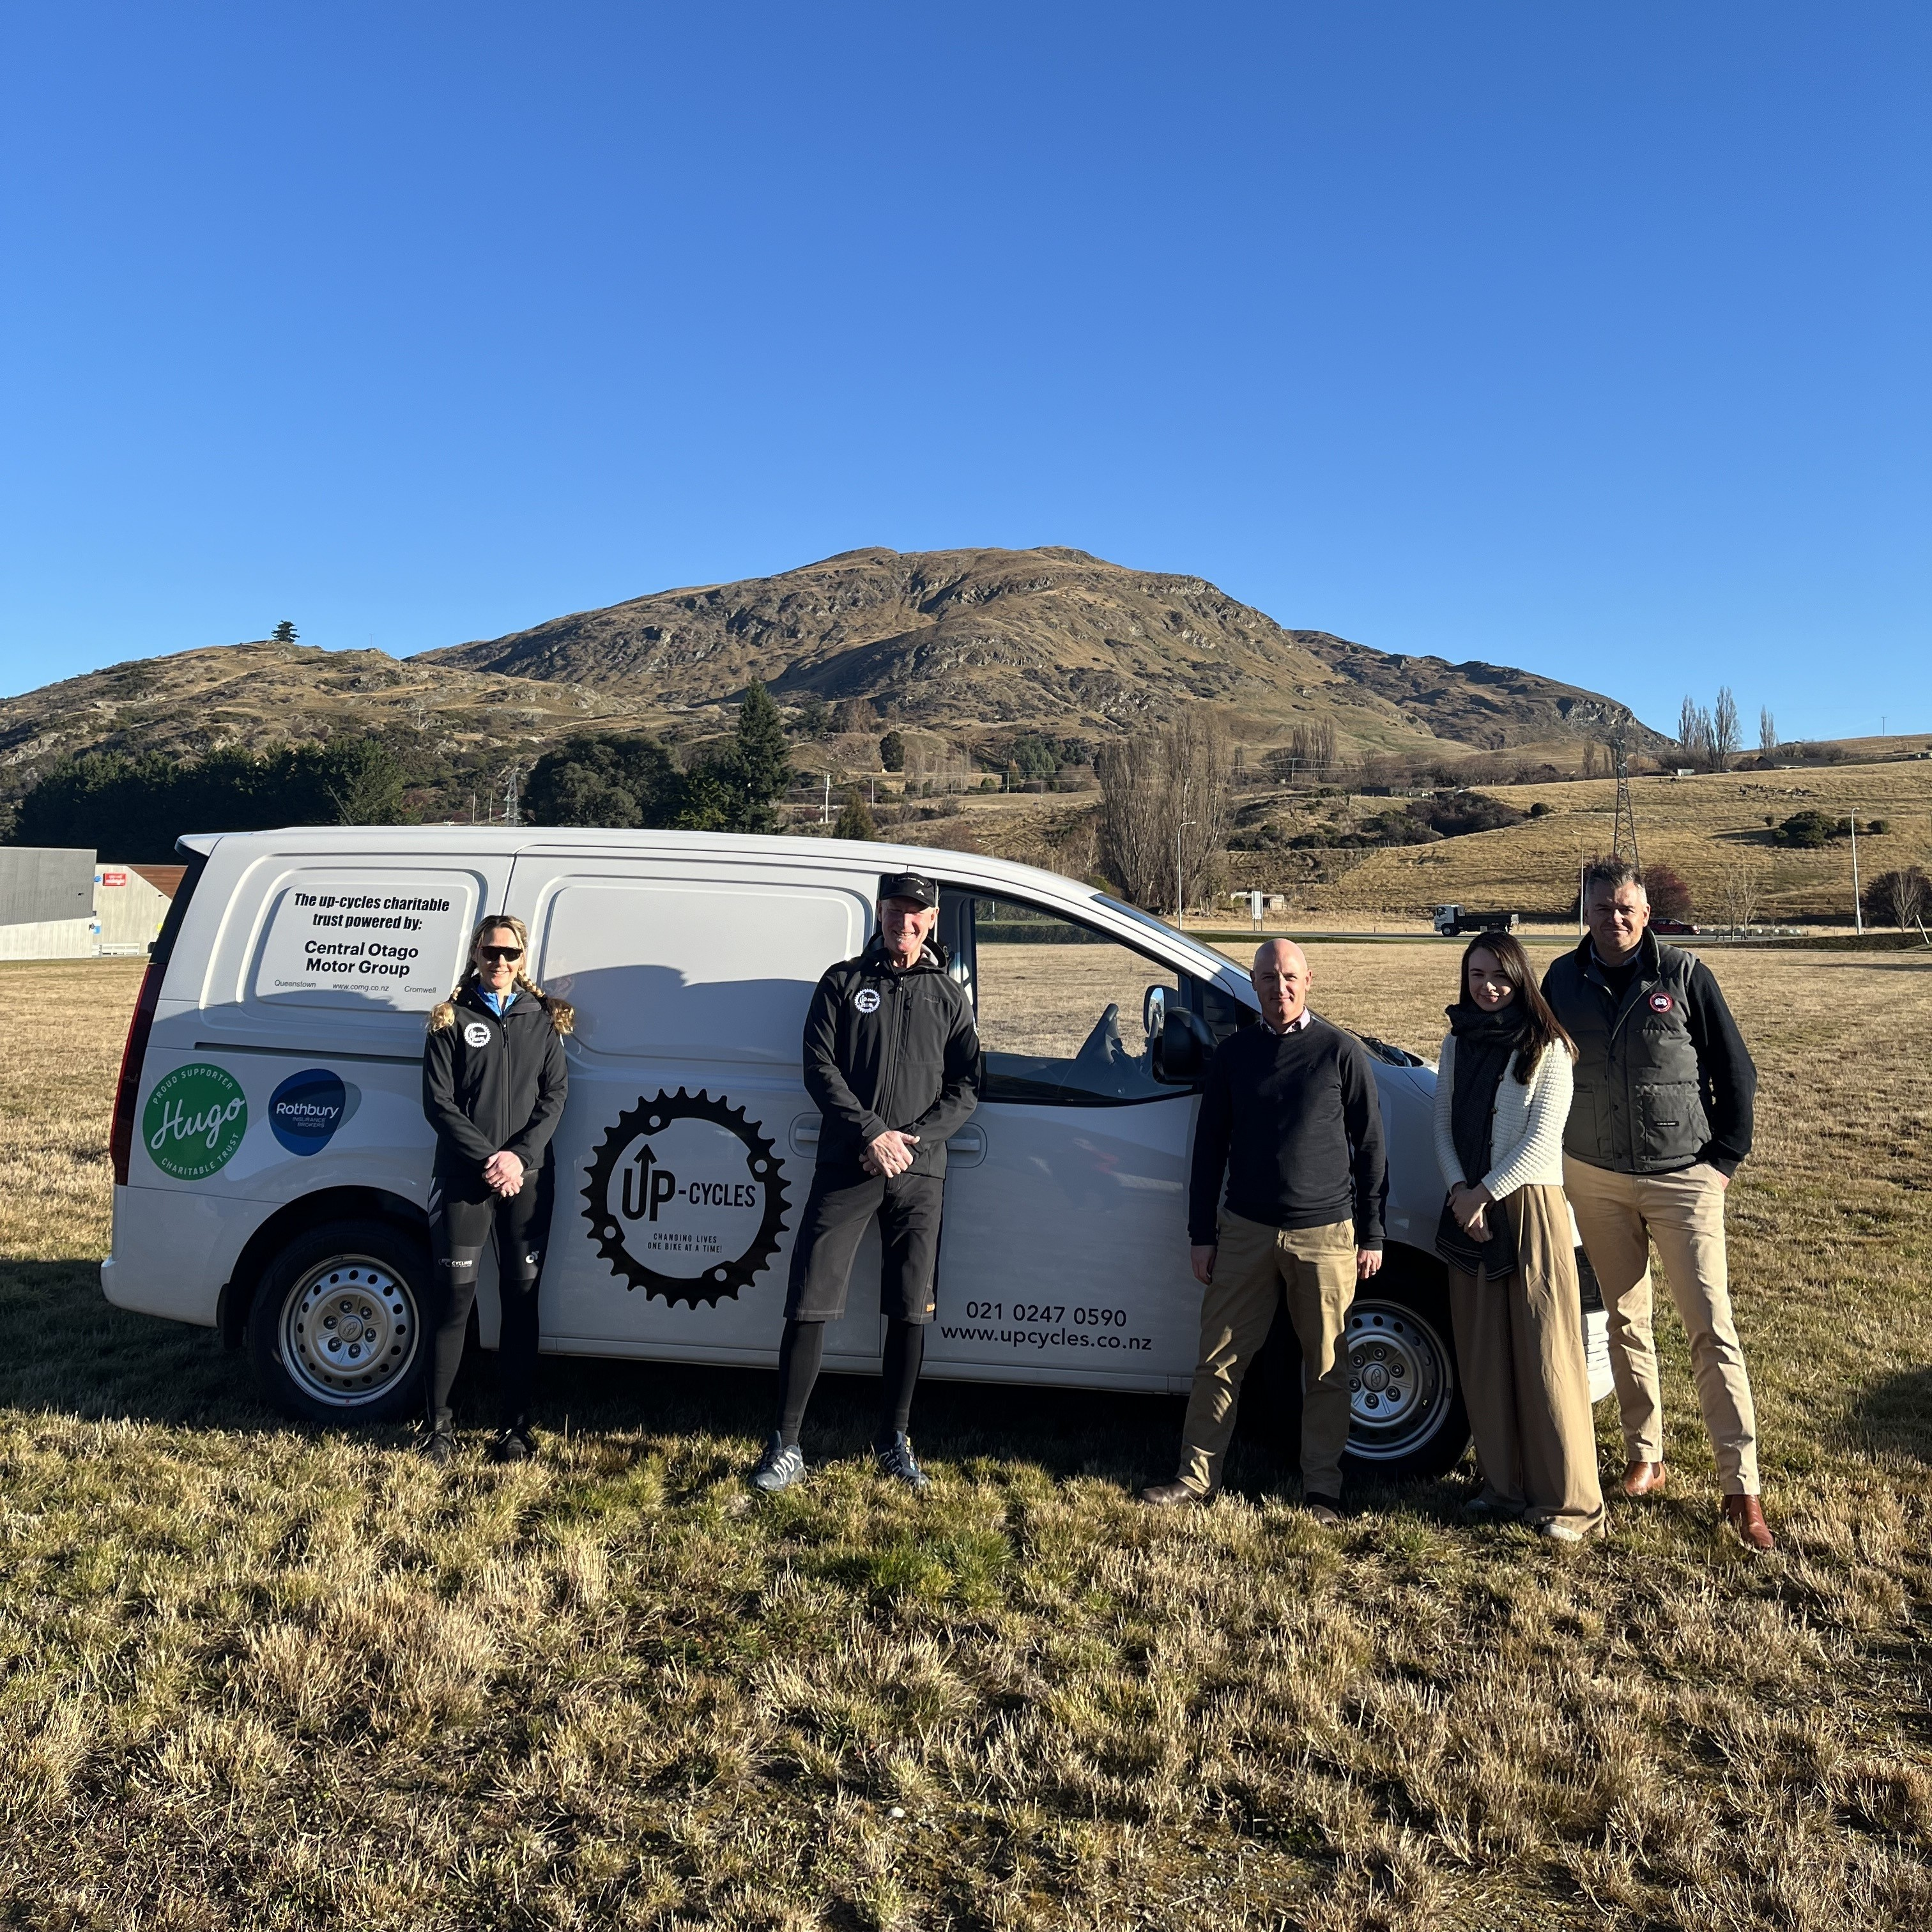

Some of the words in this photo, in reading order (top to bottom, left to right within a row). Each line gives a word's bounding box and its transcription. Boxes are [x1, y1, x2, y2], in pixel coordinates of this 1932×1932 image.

[295, 893, 316, 906] The
[319, 894, 381, 909] up-cycles
[383, 897, 450, 912] charitable
[312, 913, 343, 926] trust
[345, 915, 401, 929] powered
[403, 917, 422, 931] by:
[304, 940, 365, 956] Central
[368, 943, 418, 960] Otago
[305, 958, 355, 973] Motor
[358, 961, 410, 978] Group
[274, 979, 316, 988] Queenstown
[332, 983, 390, 992] www.comg.co.nz
[404, 985, 436, 993] Cromwell
[153, 1076, 178, 1104] PROUD
[181, 1068, 233, 1090] SUPPORTER
[276, 1103, 339, 1119] Rothbury
[150, 1097, 245, 1149] Hugo
[161, 1157, 215, 1176] CHARITABLE
[217, 1133, 240, 1163] TRUST
[647, 1241, 661, 1250] ONE
[664, 1243, 682, 1251] BIKE
[703, 1245, 723, 1254] TIME!
[696, 1235, 717, 1243] LIVES
[966, 1301, 1002, 1321] 021
[1013, 1304, 1066, 1324] 0247
[1073, 1307, 1126, 1327] 0590
[941, 1326, 1152, 1349] www.upcycles.co.nz
